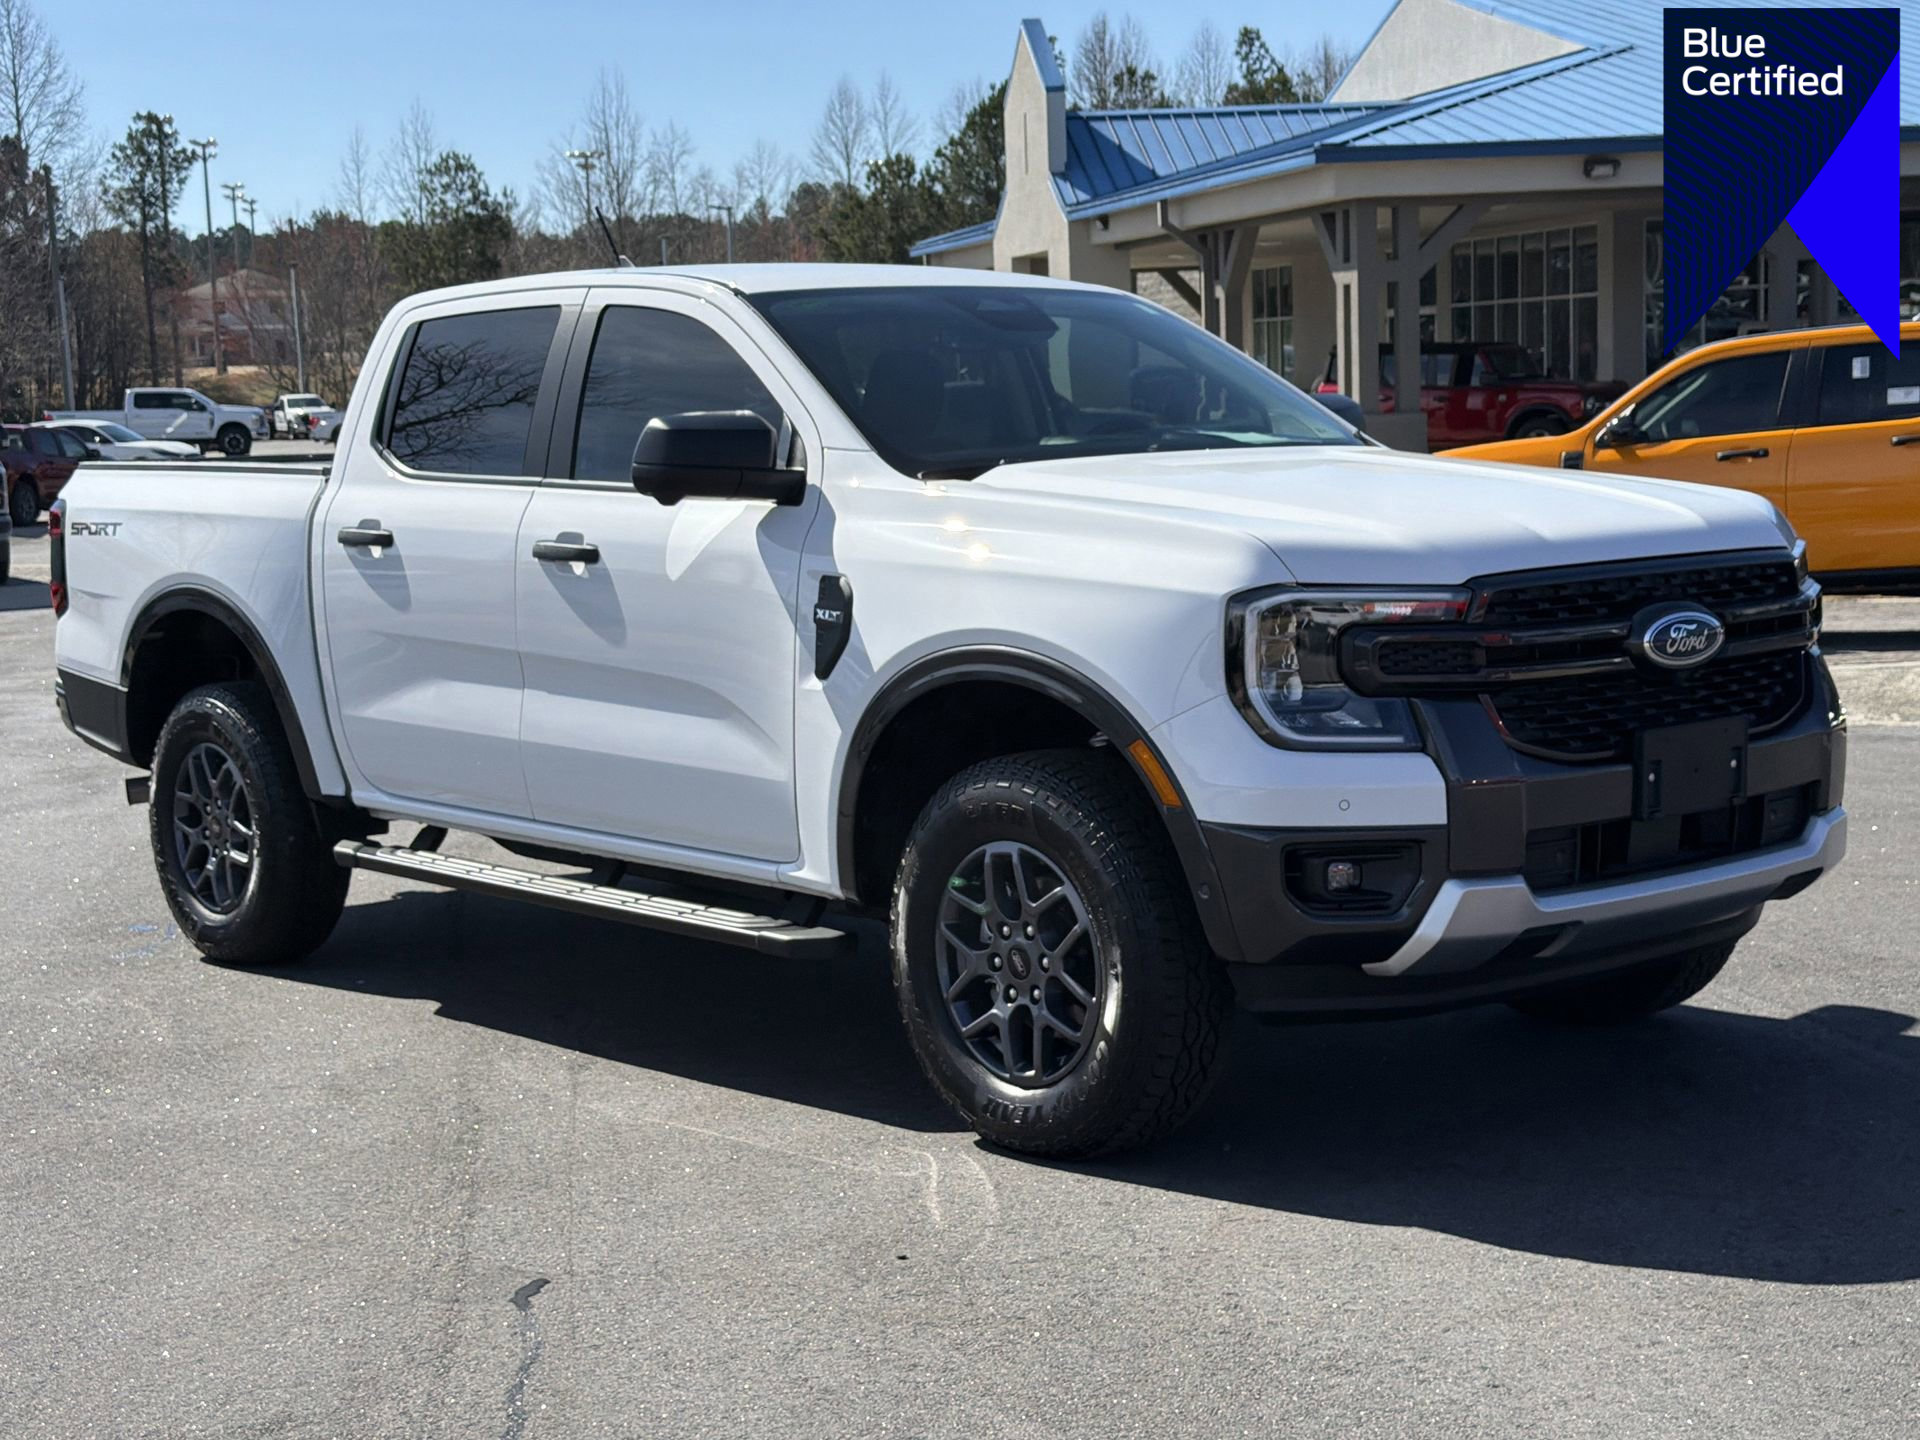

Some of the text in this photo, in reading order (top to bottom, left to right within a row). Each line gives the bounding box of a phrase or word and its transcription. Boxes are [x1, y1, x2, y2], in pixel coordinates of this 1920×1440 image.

[70, 522, 123, 536] SPORT
[815, 608, 842, 621] XLT
[1666, 623, 1708, 654] Ford
